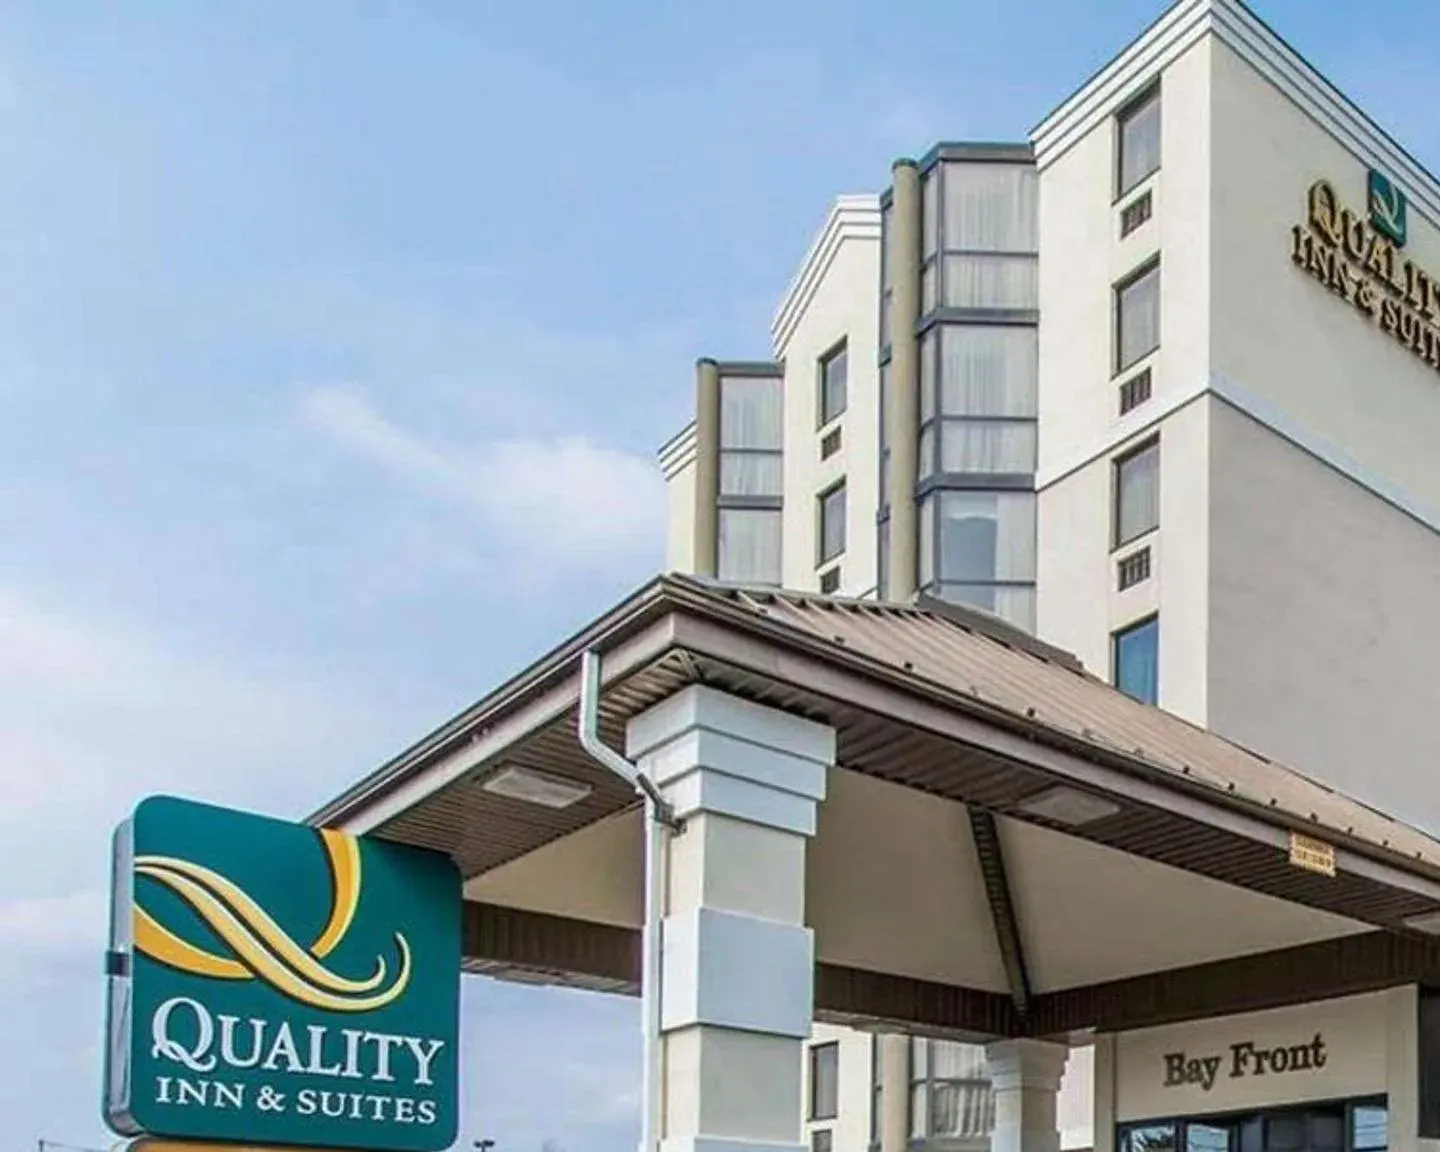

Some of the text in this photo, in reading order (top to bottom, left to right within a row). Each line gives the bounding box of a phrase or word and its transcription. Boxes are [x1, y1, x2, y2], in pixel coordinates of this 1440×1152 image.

[1291, 224, 1354, 299] INN
[1352, 279, 1375, 317] &
[152, 996, 445, 1085] QUALITY
[1164, 1032, 1327, 1091] Bay Front
[156, 1076, 437, 1124] INN & SUITES
